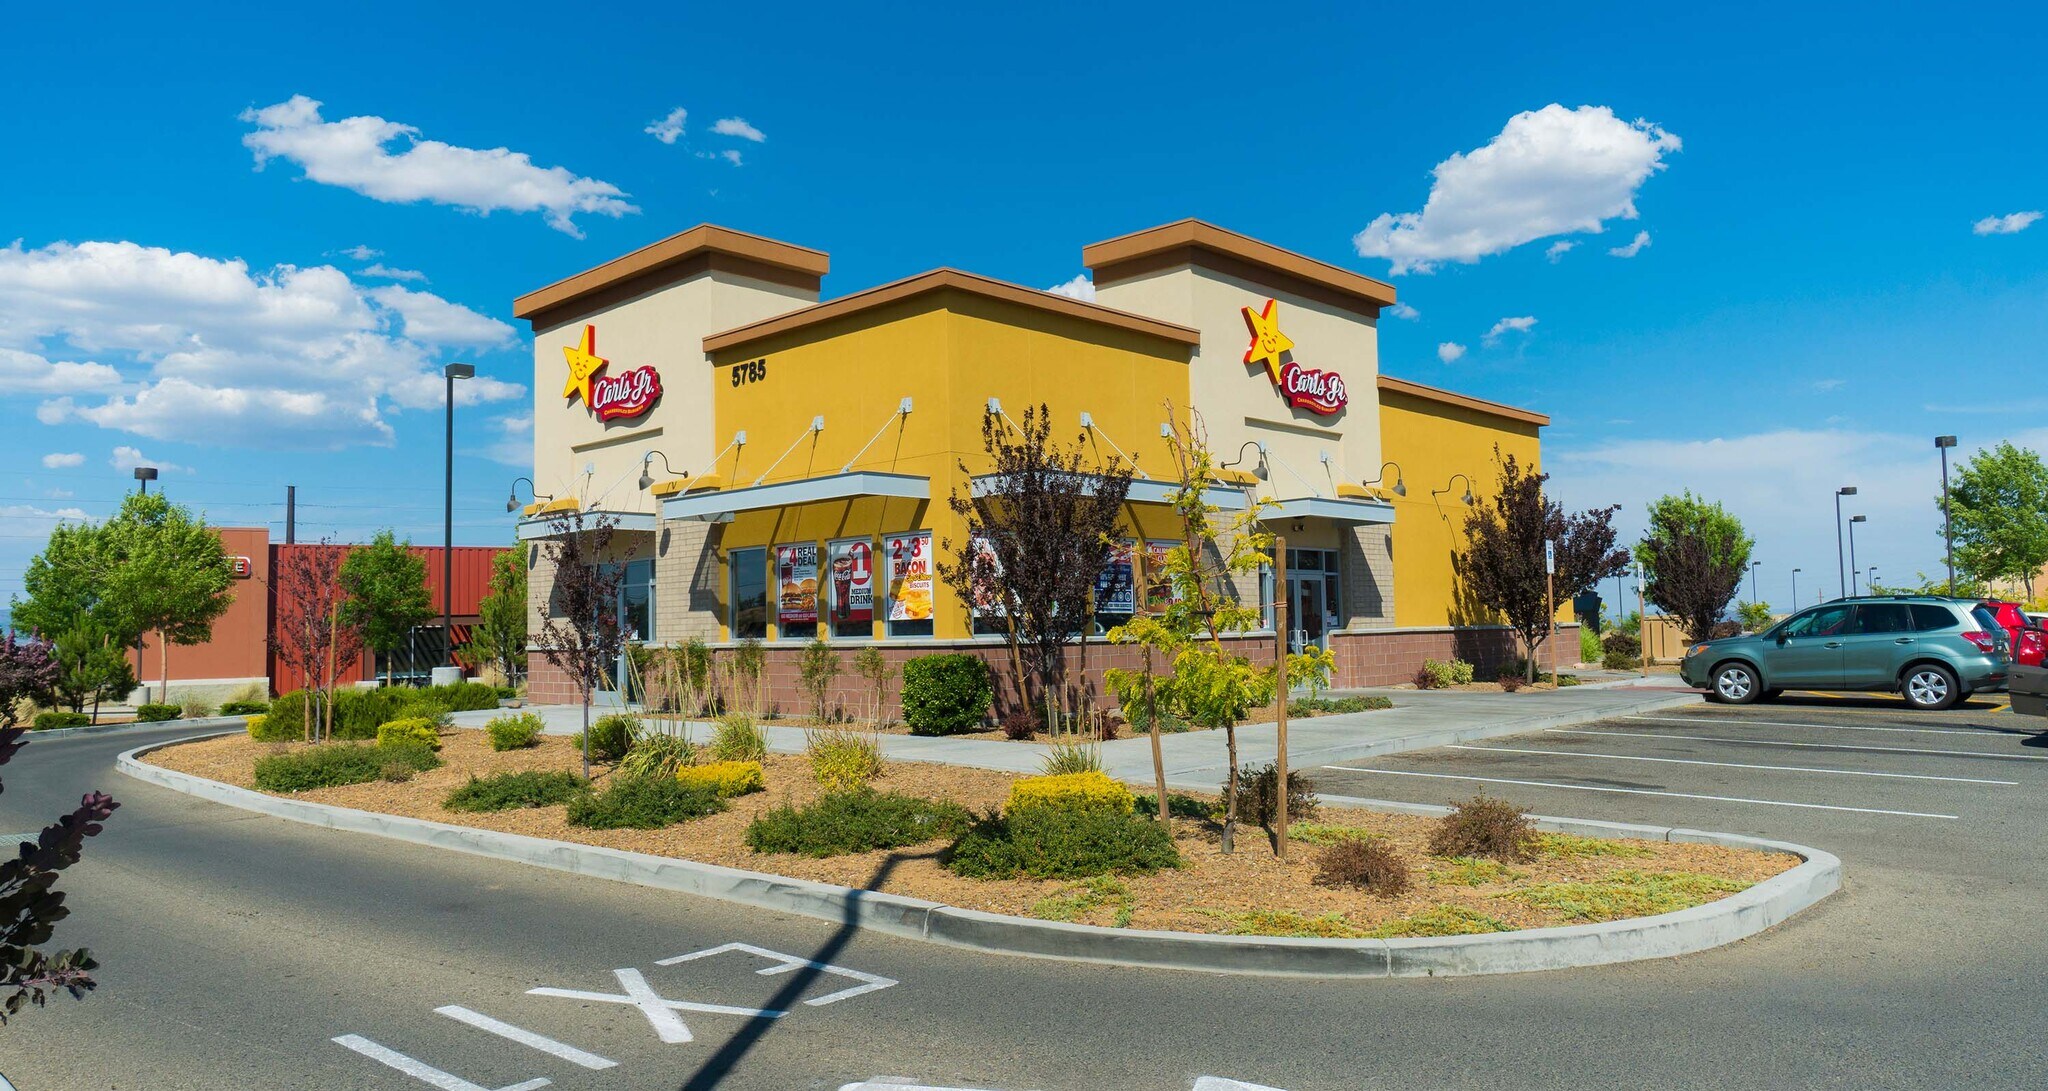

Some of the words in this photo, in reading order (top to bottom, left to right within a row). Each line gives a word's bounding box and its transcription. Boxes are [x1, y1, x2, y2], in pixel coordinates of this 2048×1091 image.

[732, 359, 766, 387] 5785
[593, 373, 632, 408] Carl's
[632, 370, 654, 400] Jr.
[1286, 367, 1326, 396] Carl's
[1326, 376, 1348, 402] Jr.
[797, 547, 817, 556] REAL
[893, 539, 903, 559] 2
[797, 557, 817, 566] DEAL
[852, 545, 868, 579] 1
[894, 561, 926, 575] BACON
[850, 595, 872, 605] DRINK
